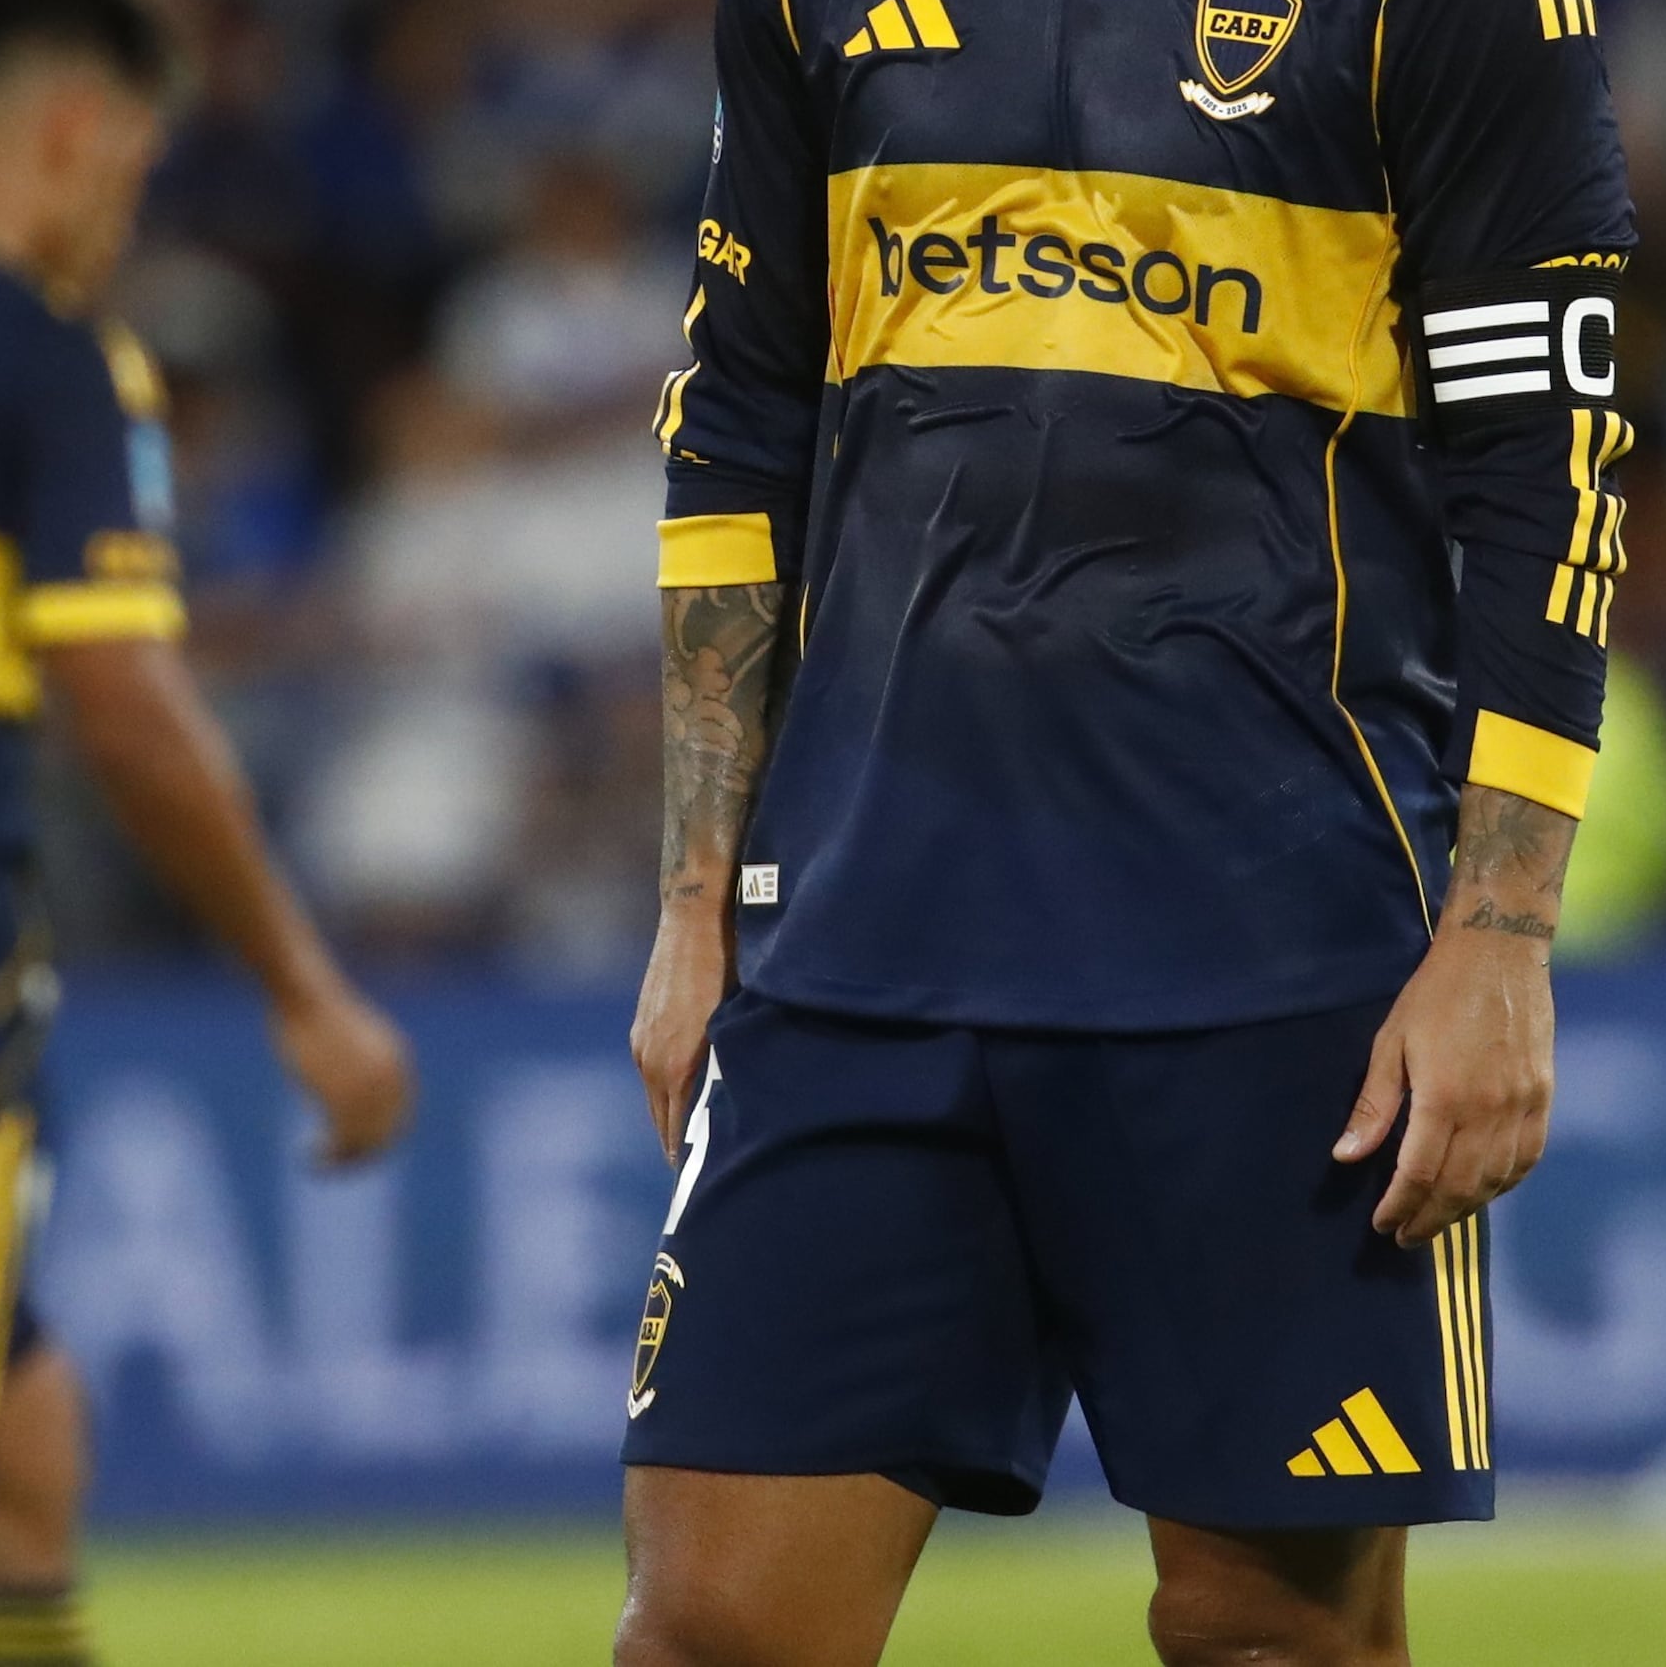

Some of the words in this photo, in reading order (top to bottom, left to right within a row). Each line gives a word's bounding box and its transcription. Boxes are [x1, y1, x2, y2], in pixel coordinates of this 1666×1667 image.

[1210, 13, 1279, 40] CABJ
[1226, 102, 1248, 115] 2025
[867, 215, 1263, 334] betsson
